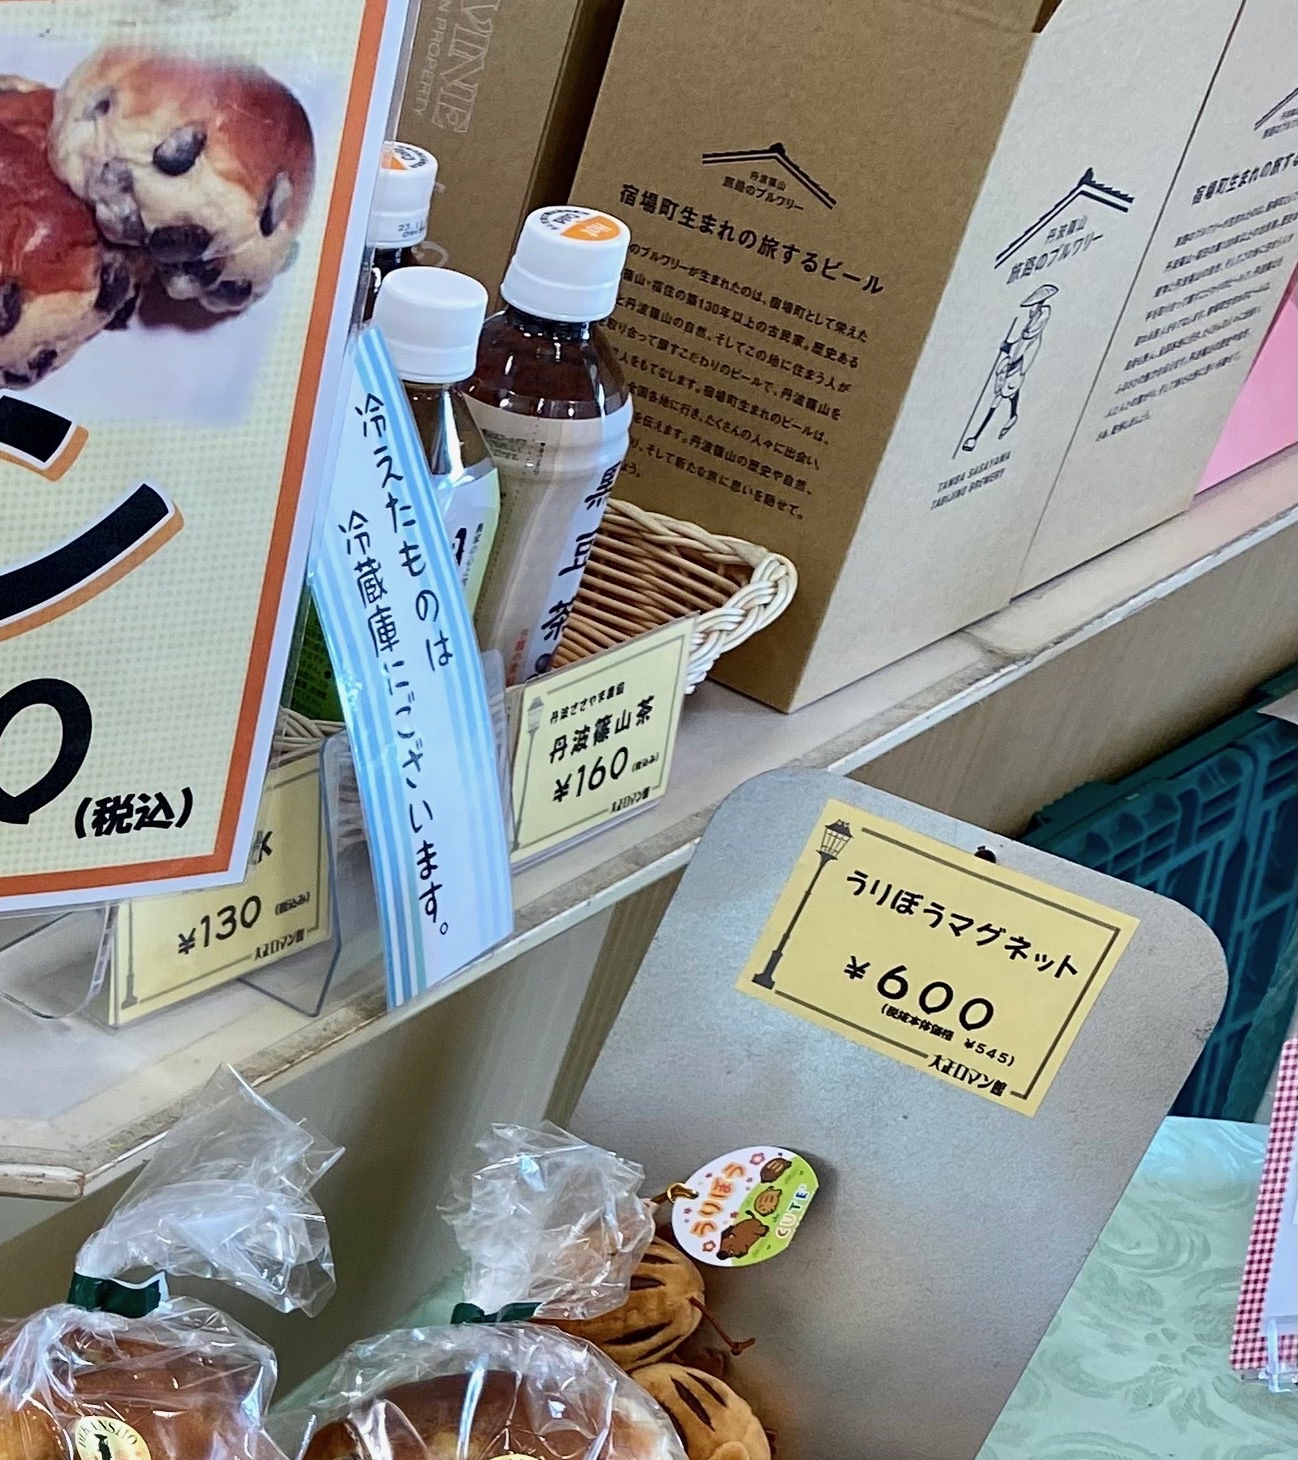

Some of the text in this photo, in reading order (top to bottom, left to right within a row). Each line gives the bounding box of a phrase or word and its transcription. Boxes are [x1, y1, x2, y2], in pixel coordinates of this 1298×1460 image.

[619, 183, 884, 295] 宿場町生まれの旅するビール
[354, 392, 454, 673] 冷えたものは
[338, 509, 449, 936] 冷蔵庫にございます。
[549, 694, 656, 765] 丹波篠山茶
[74, 786, 194, 839] (税込)
[552, 746, 629, 803] ¥160
[177, 895, 262, 955] ¥130
[846, 869, 1079, 980] うりぼうマグネット
